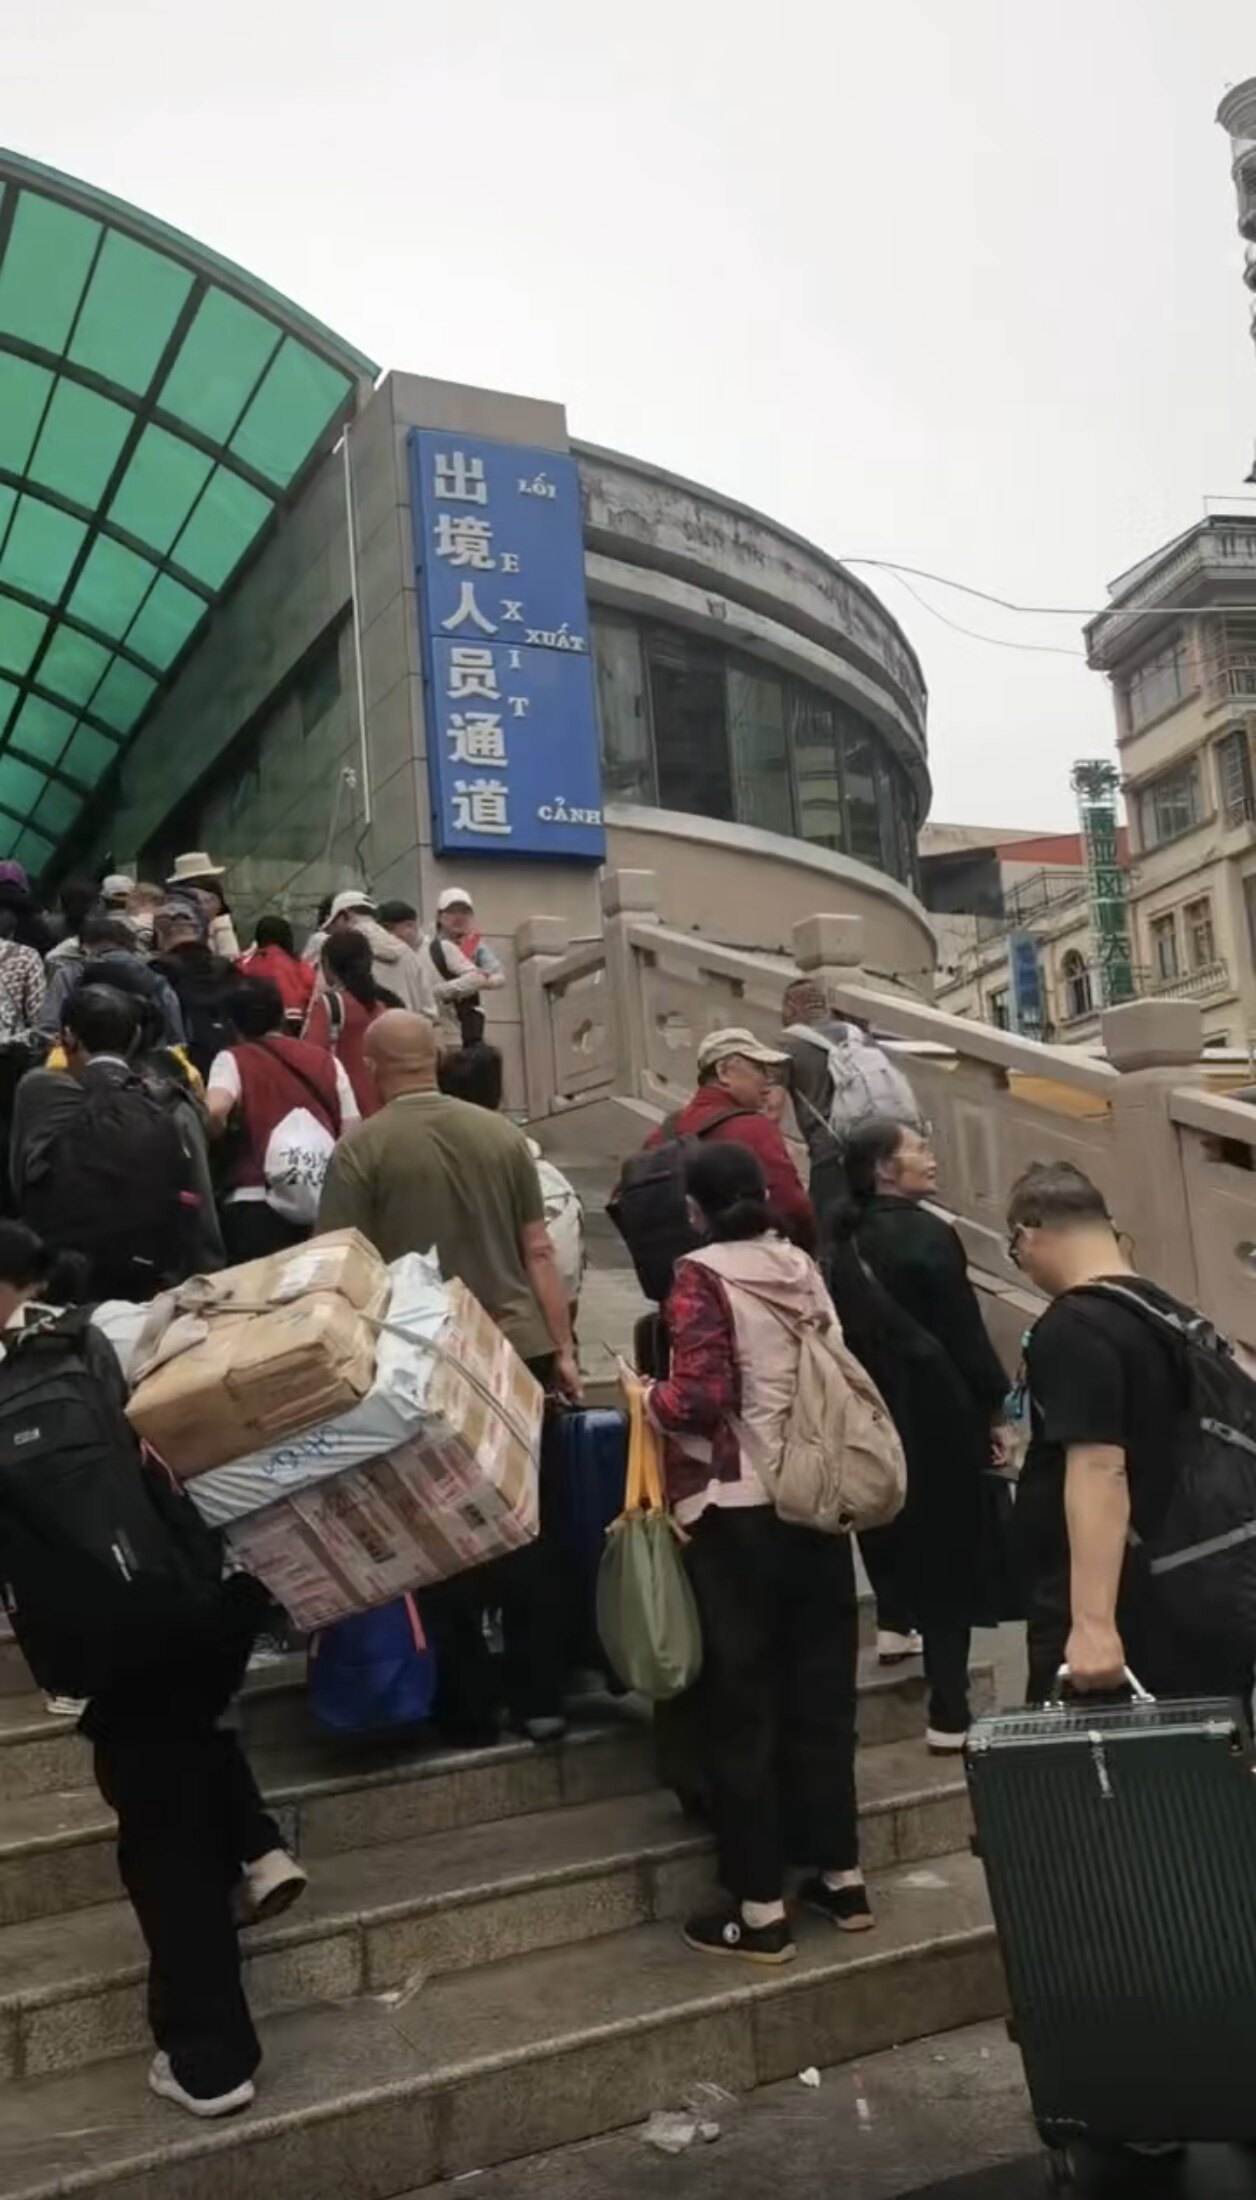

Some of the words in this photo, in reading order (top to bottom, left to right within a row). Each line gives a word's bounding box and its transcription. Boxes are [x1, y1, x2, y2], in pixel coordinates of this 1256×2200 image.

[518, 472, 558, 499] LỐI
[433, 450, 513, 837] 出境人员通道
[525, 623, 585, 652] XUẤT
[537, 796, 603, 825] CẢNH
